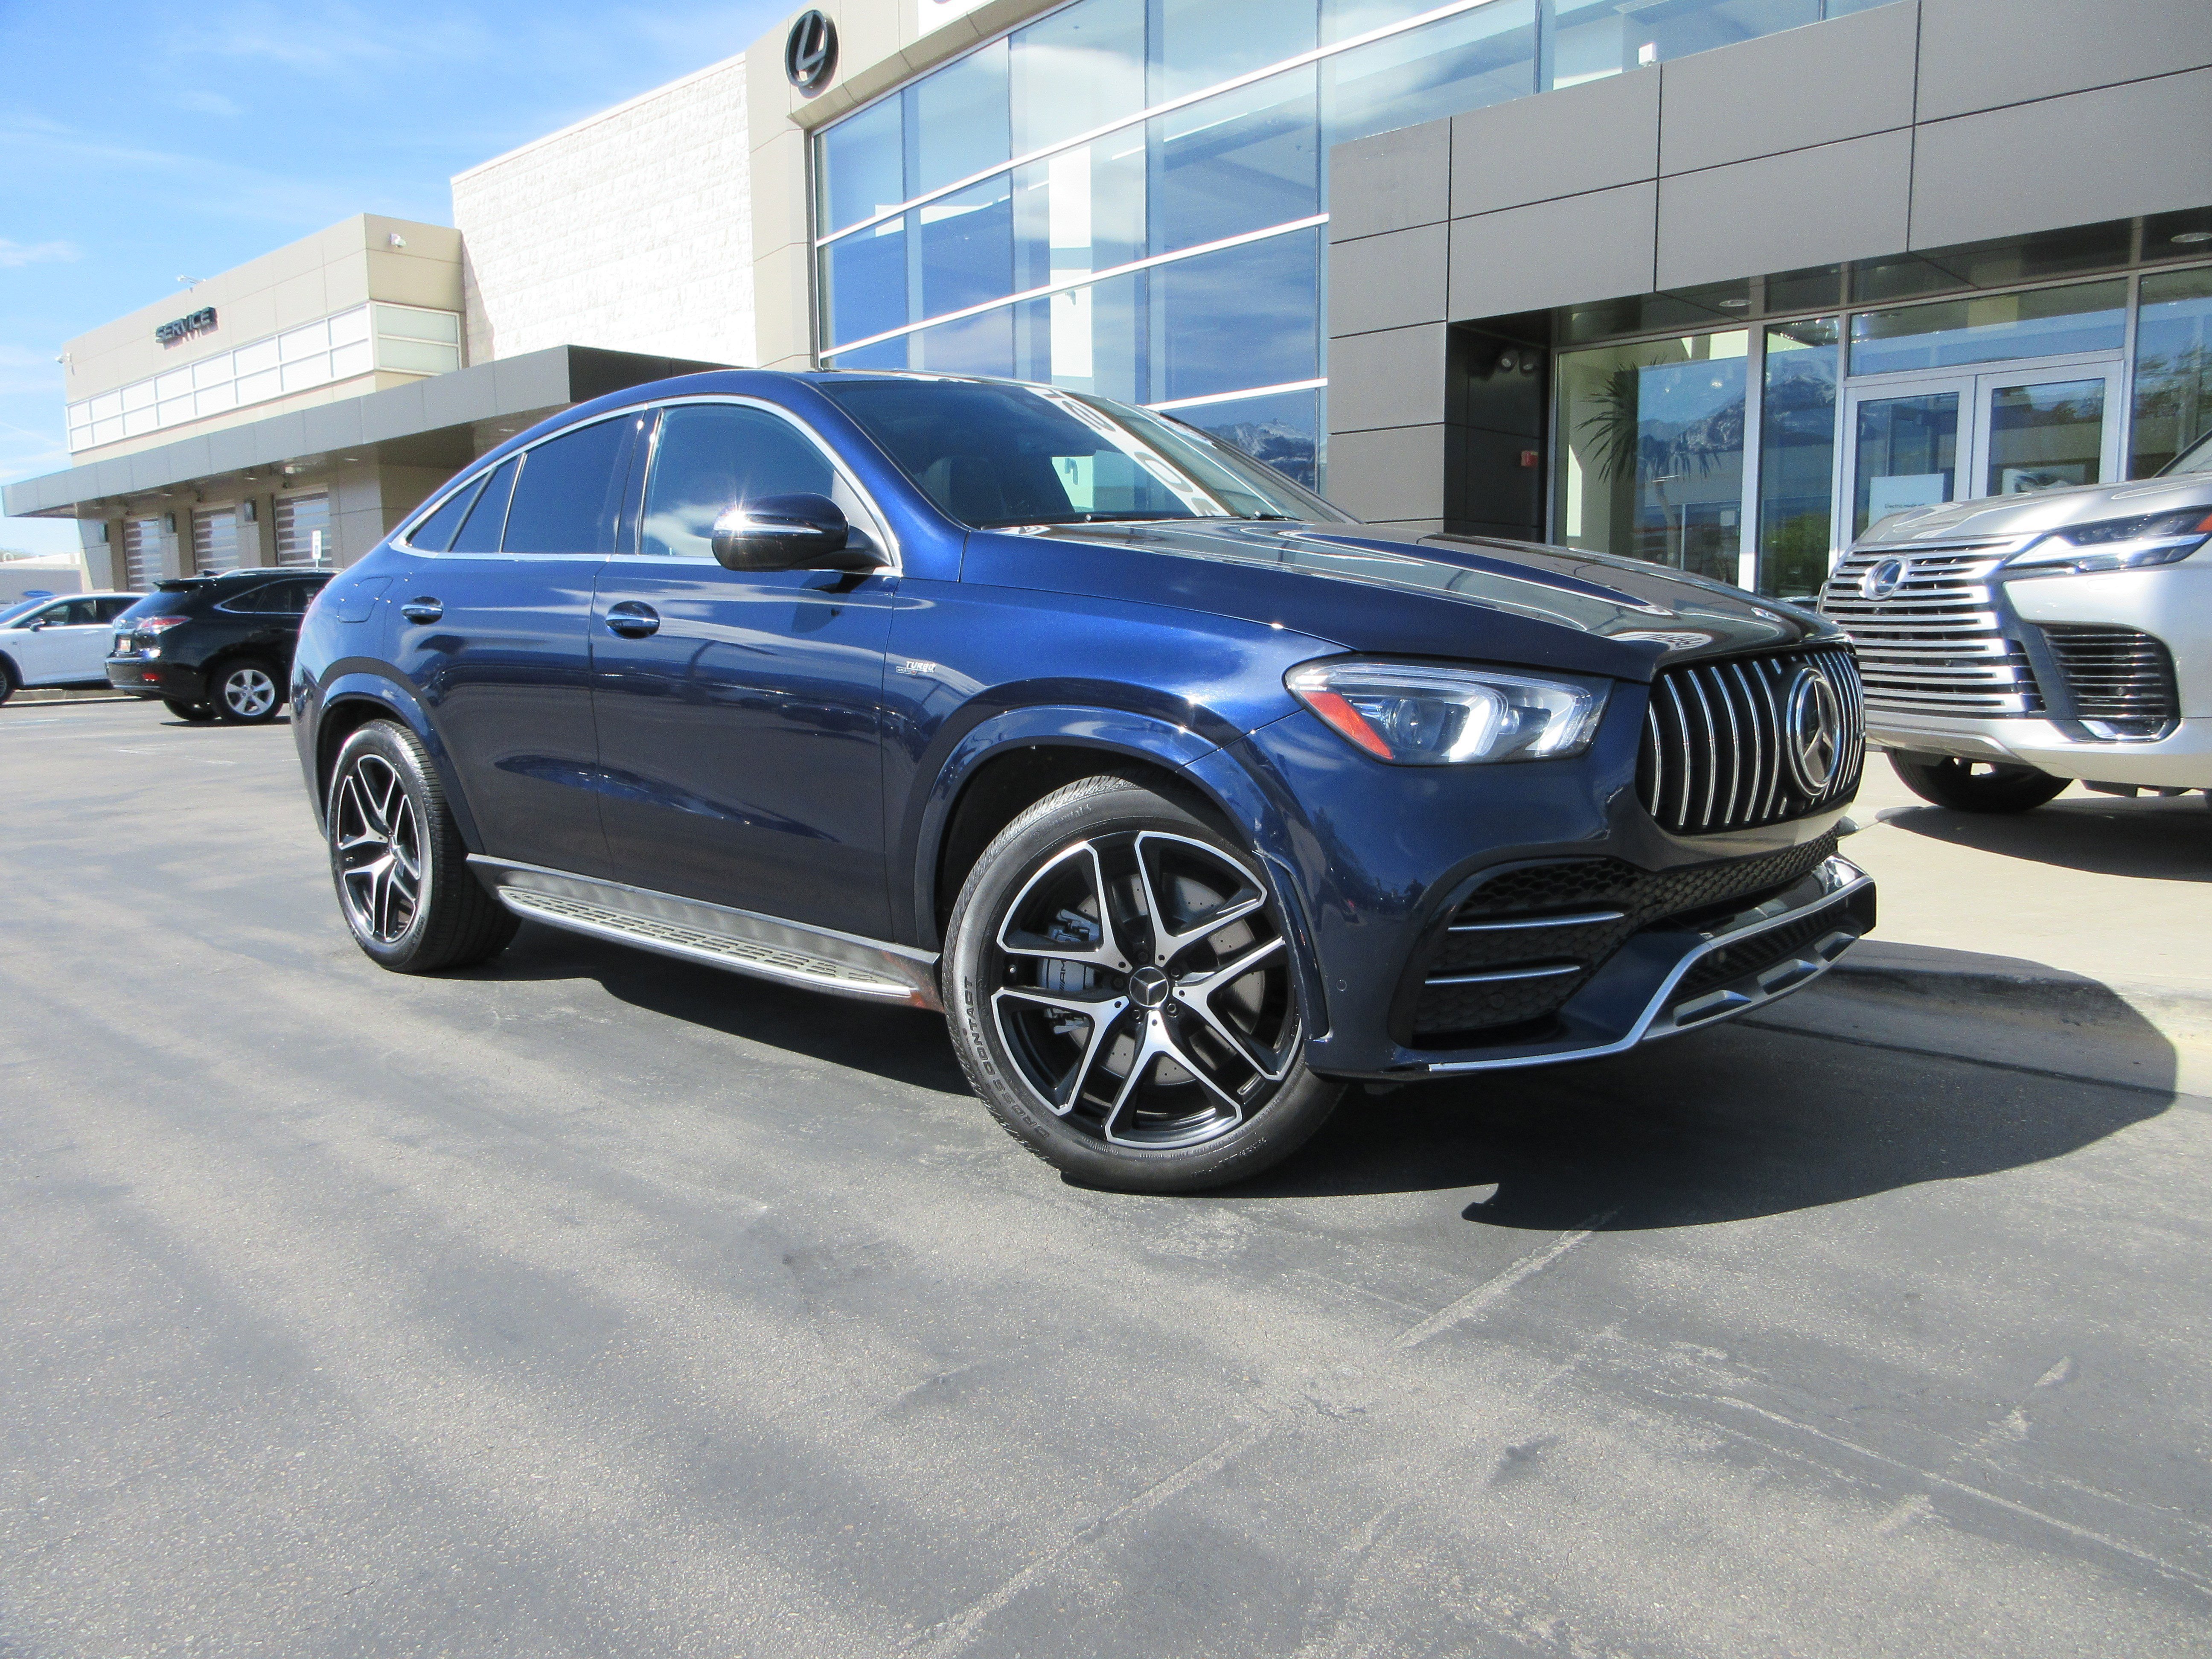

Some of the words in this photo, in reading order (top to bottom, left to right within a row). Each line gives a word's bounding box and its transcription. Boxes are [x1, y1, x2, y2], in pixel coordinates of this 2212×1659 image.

[155, 307, 216, 340] SERVICE
[906, 661, 936, 671] TURBO
[964, 976, 996, 1075] CONTACT
[992, 1079, 1050, 1138] CROSS
